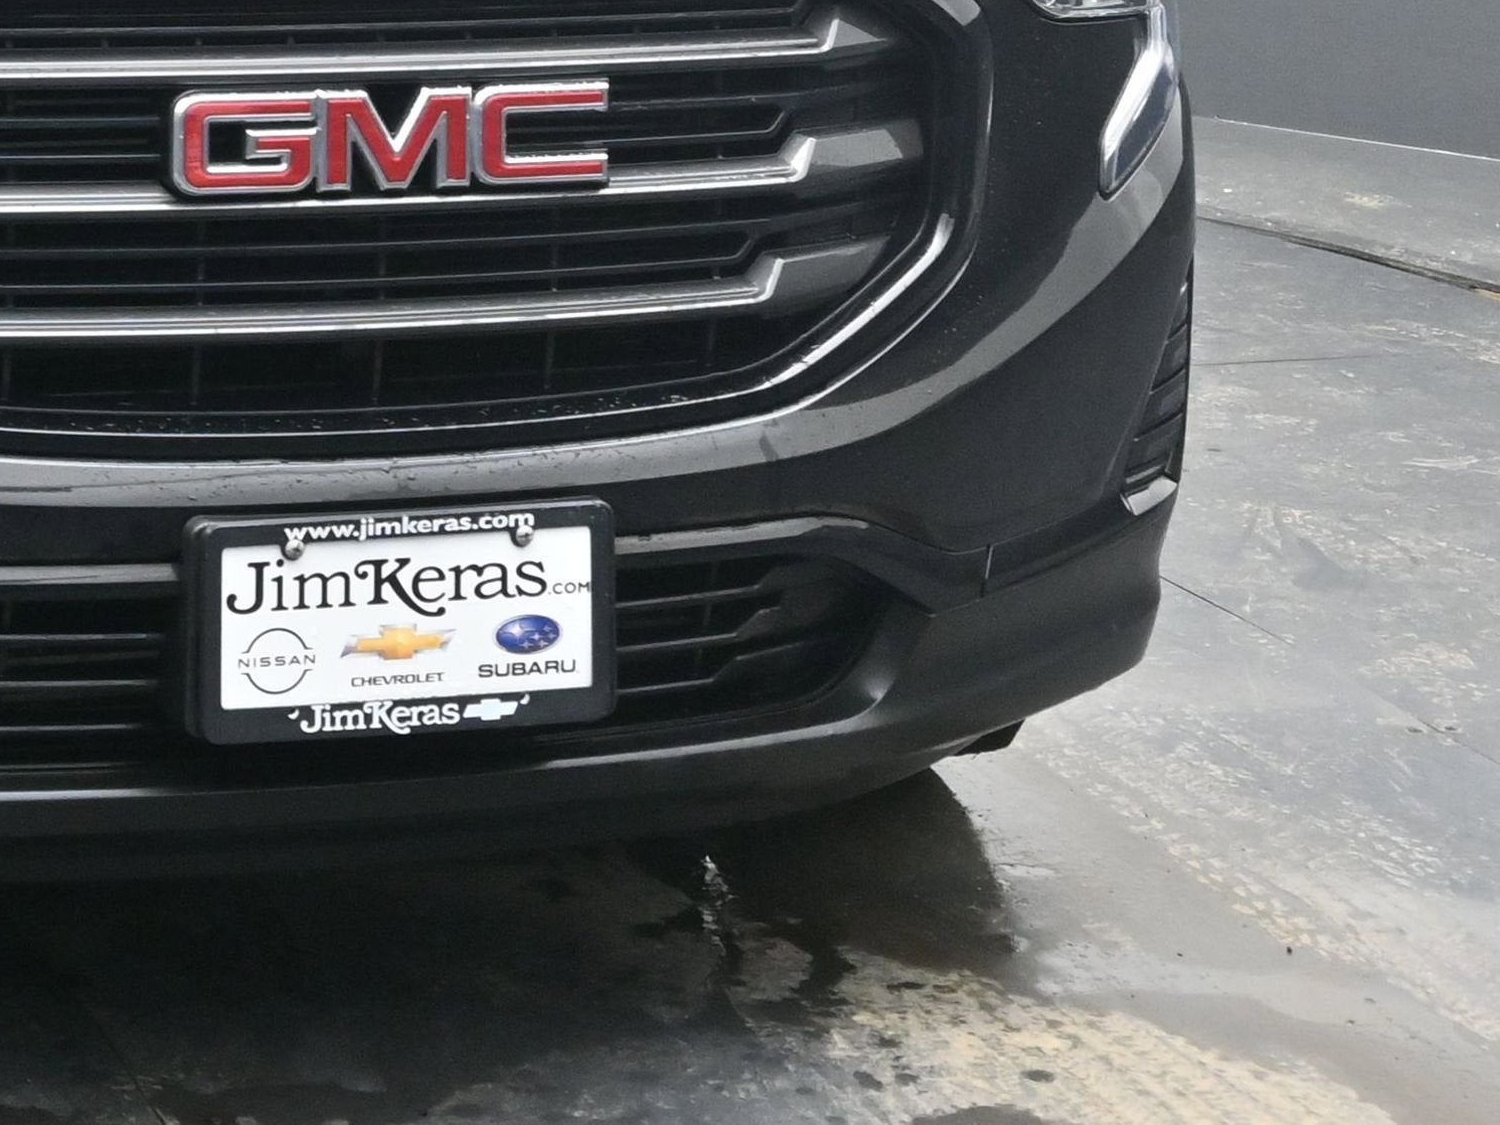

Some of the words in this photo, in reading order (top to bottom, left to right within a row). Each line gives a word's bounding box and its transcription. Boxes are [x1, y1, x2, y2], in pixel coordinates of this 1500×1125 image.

[173, 78, 609, 195] GMC
[284, 513, 535, 541] www.jimkeras.com
[238, 653, 316, 669] NISSAN
[478, 659, 576, 678] SUBARU
[351, 672, 444, 687] CHEVROLET
